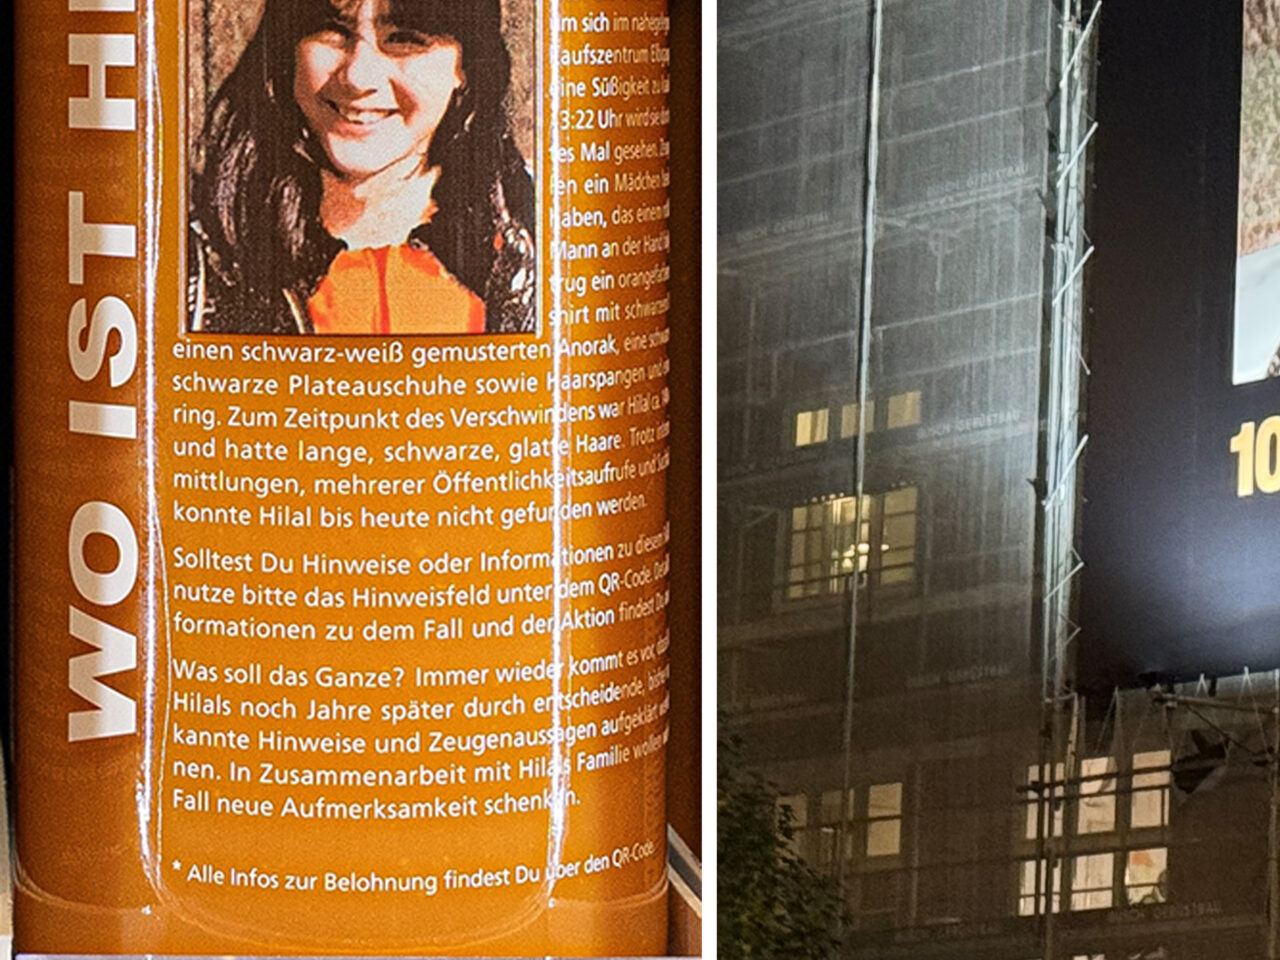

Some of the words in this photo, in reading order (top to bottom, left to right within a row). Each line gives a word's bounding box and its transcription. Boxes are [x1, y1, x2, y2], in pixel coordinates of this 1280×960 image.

[582, 12, 610, 32] sich
[613, 11, 629, 32] im
[592, 75, 649, 101] Süßigkeit
[598, 107, 623, 129] Uhr
[581, 140, 610, 162] Mal
[584, 173, 609, 194] ein
[611, 204, 634, 225] das
[550, 241, 597, 260] Mann
[601, 242, 619, 259] an
[622, 236, 642, 256] der
[591, 270, 614, 291] ein
[68, 192, 137, 439] IST
[595, 301, 621, 322] mit
[172, 340, 233, 360] einen
[241, 341, 403, 363] schwarz-weiß
[412, 344, 552, 368] gemusterten
[557, 335, 619, 356] Anorak,
[172, 371, 278, 394] schwarze
[289, 374, 466, 396] Plateauschuhe
[476, 372, 538, 394] sowie
[547, 366, 645, 391] Haarspangen
[173, 404, 221, 430] ring.
[228, 406, 277, 427] Zum
[284, 408, 399, 434] Zeitpunkt
[406, 409, 444, 428] des
[450, 402, 596, 428] Verschwindens
[598, 402, 624, 419] war
[173, 437, 216, 458] und
[225, 438, 288, 460] hatte
[299, 440, 374, 467] lange,
[384, 441, 500, 462] schwarze,
[509, 437, 569, 464] glatte
[576, 434, 625, 455] Haare.
[173, 470, 305, 499] mittlungen,
[315, 473, 426, 495] mehrerer
[433, 459, 636, 494] Öffentlichkeitsaufrufe
[174, 500, 250, 523] konnte
[260, 506, 311, 526] Hilal
[321, 506, 352, 527] bis
[361, 507, 430, 527] heute
[438, 505, 494, 526] nicht
[501, 499, 592, 530] gefunden
[597, 491, 648, 514] werden.
[173, 547, 253, 571] Solltest
[261, 552, 293, 573] Du
[302, 554, 411, 575] Hinweise
[419, 552, 472, 574] oder
[481, 543, 614, 572] Informationen
[618, 541, 633, 558] zu
[173, 584, 235, 604] nutze
[243, 584, 297, 606] bitte
[305, 586, 345, 607] das
[353, 584, 490, 608] Hinweisfeld
[497, 585, 552, 604] unter
[559, 578, 594, 598] dem
[68, 499, 140, 743] WO
[173, 611, 316, 639] formationen
[325, 624, 353, 640] zu
[362, 620, 415, 641] dem
[424, 618, 463, 639] Fall
[472, 615, 514, 638] und
[521, 613, 554, 634] der
[560, 607, 615, 632] Aktion
[172, 658, 218, 683] Was
[224, 663, 261, 684] soll
[269, 664, 308, 686] das
[315, 667, 404, 688] Ganze?
[416, 666, 488, 687] Immer
[496, 659, 563, 683] wieder
[569, 651, 623, 678] kommt
[626, 648, 639, 667] es
[173, 691, 231, 716] Hilals
[240, 698, 296, 719] noch
[307, 699, 372, 721] Jahre
[381, 700, 453, 726] später
[463, 694, 525, 719] durch
[173, 723, 250, 750] kannte
[258, 730, 366, 754] Hinweise
[375, 732, 420, 754] und
[429, 723, 596, 756] Zeugenaussagen
[173, 761, 221, 780] nen.
[230, 762, 250, 782] In
[259, 764, 465, 786] Zusammenarbeit
[474, 762, 511, 783] mit
[519, 755, 571, 779] Hilals
[577, 746, 630, 772] Familie
[173, 789, 209, 812] Fall
[218, 796, 273, 816] neue
[281, 795, 477, 820] Aufmerksamkeit
[484, 790, 580, 816] schenkn.
[187, 864, 224, 885] Alle
[230, 868, 279, 889] Infos
[284, 875, 317, 891] zur
[325, 872, 437, 895] Belohnung
[443, 868, 510, 889] findest
[515, 865, 539, 884] Du
[584, 854, 609, 874] den
